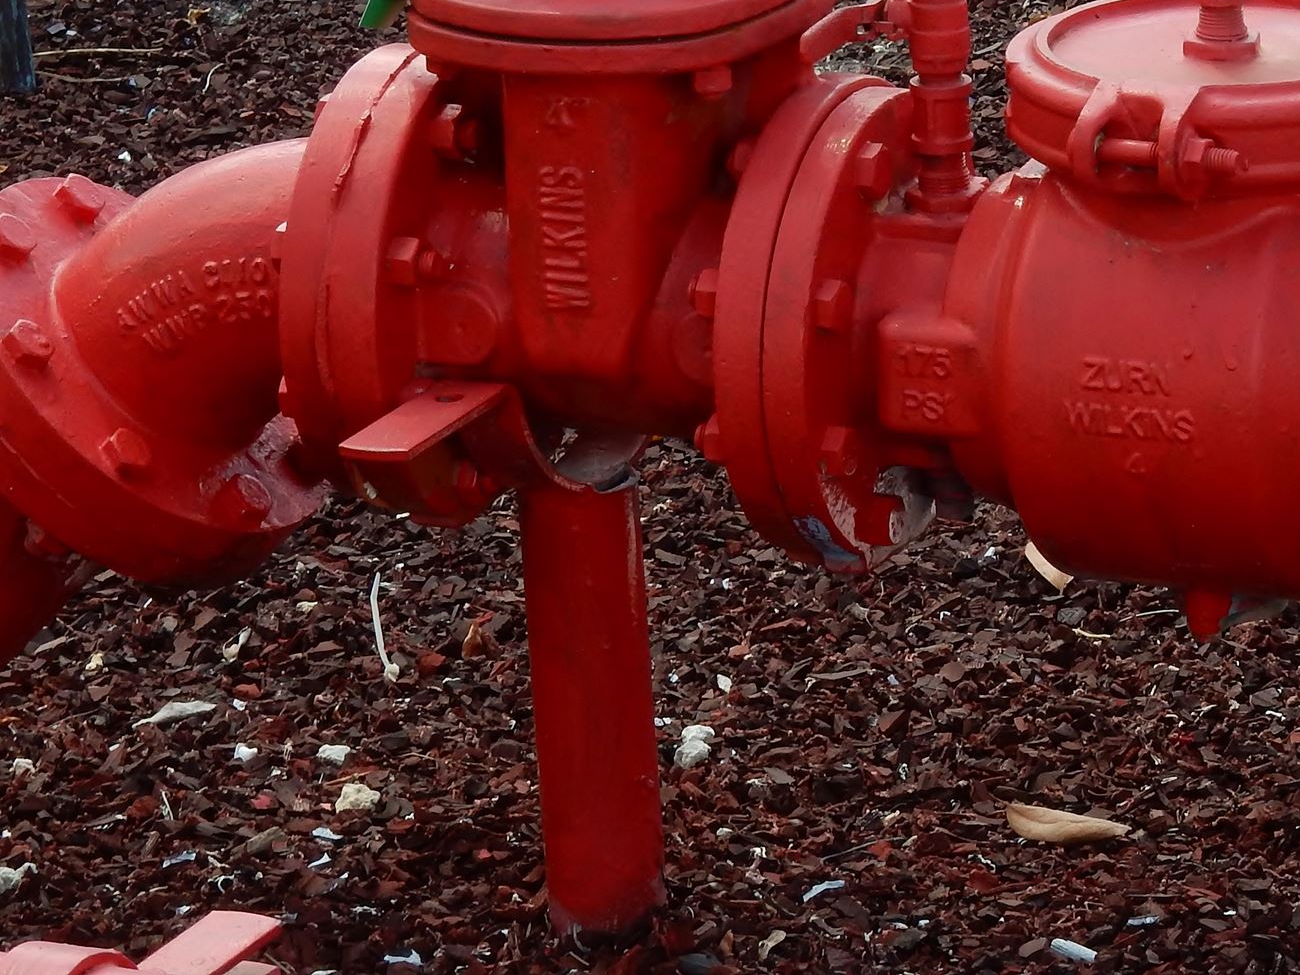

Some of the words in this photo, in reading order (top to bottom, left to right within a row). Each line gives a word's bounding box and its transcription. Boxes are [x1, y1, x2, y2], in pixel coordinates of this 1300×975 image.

[540, 165, 590, 308] WILKINS
[1082, 354, 1172, 396] ZURN
[1063, 400, 1195, 442] WILKINS
